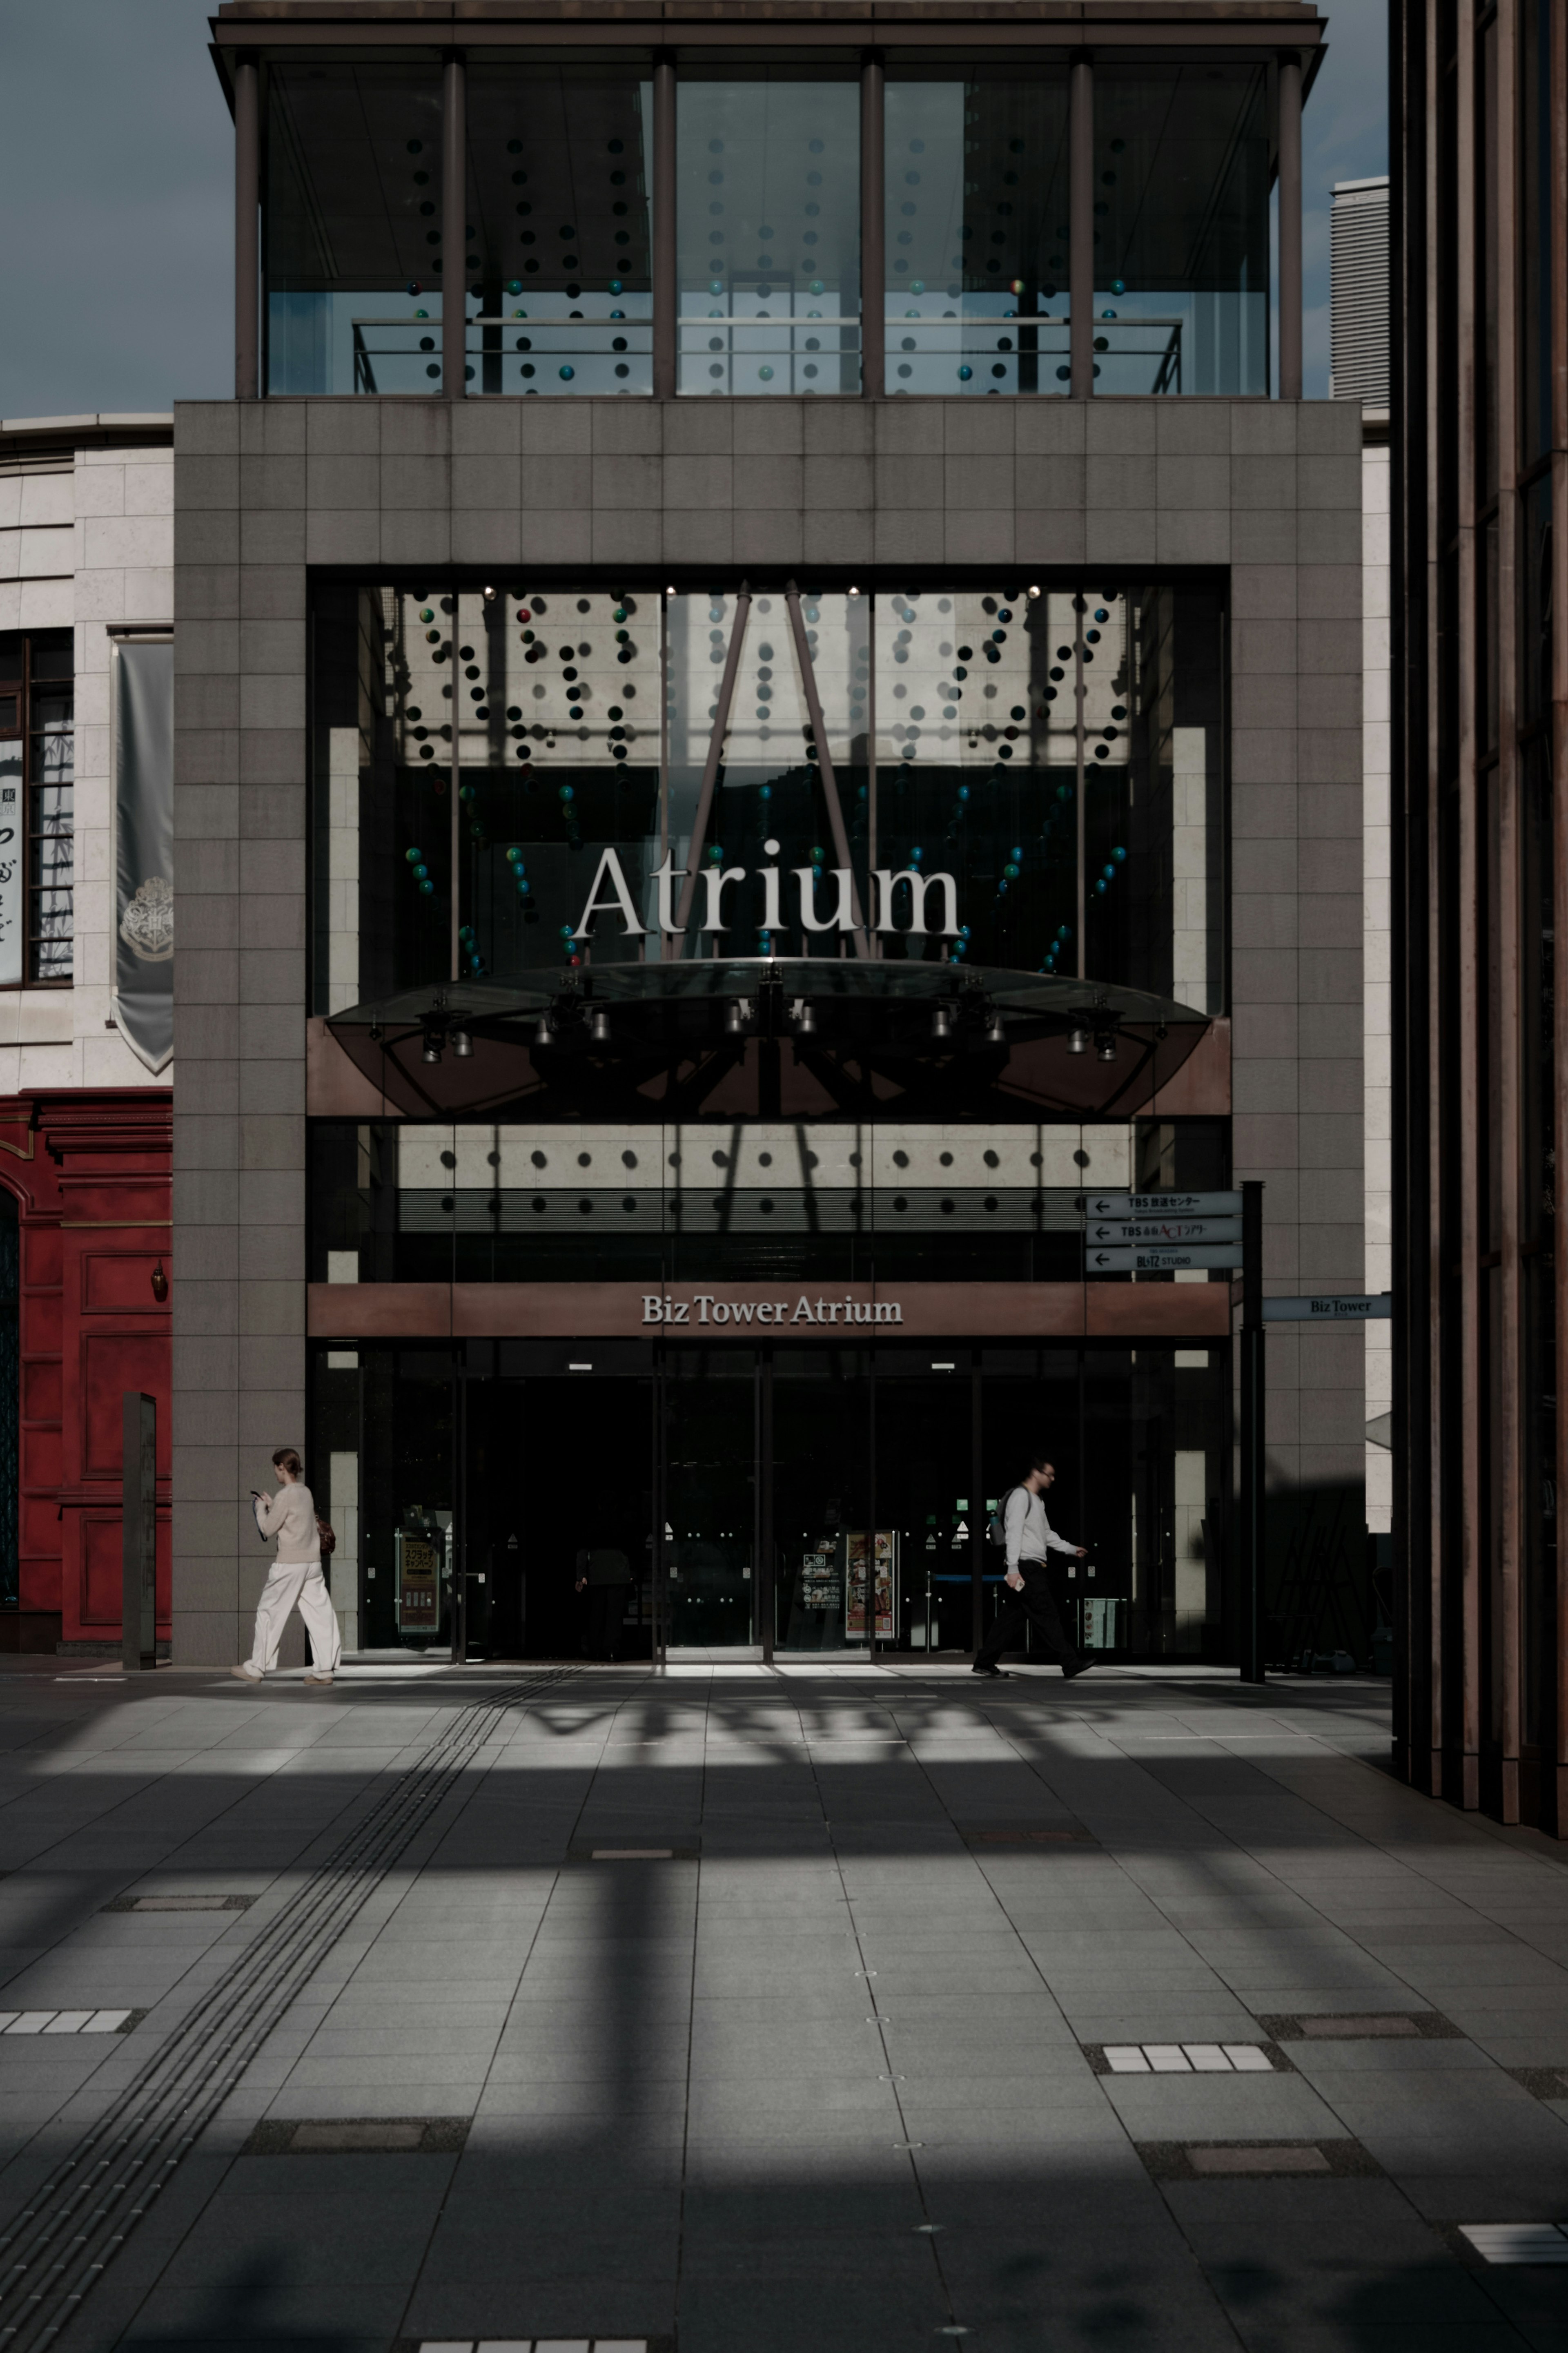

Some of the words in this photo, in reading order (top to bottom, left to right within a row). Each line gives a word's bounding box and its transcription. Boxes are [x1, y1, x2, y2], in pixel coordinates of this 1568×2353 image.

[573, 839, 963, 939] Atrium
[1128, 1198, 1148, 1207] TBS
[1151, 1197, 1200, 1207] 放送センター
[1121, 1227, 1141, 1237] TBS
[1162, 1256, 1191, 1265] STUDIO
[642, 1296, 690, 1323] Biz
[694, 1296, 788, 1323] Tower
[790, 1296, 903, 1323] Atrium
[1311, 1300, 1331, 1312] Biz
[1332, 1300, 1372, 1312] Tower
[405, 1550, 433, 1559] スクラッチ
